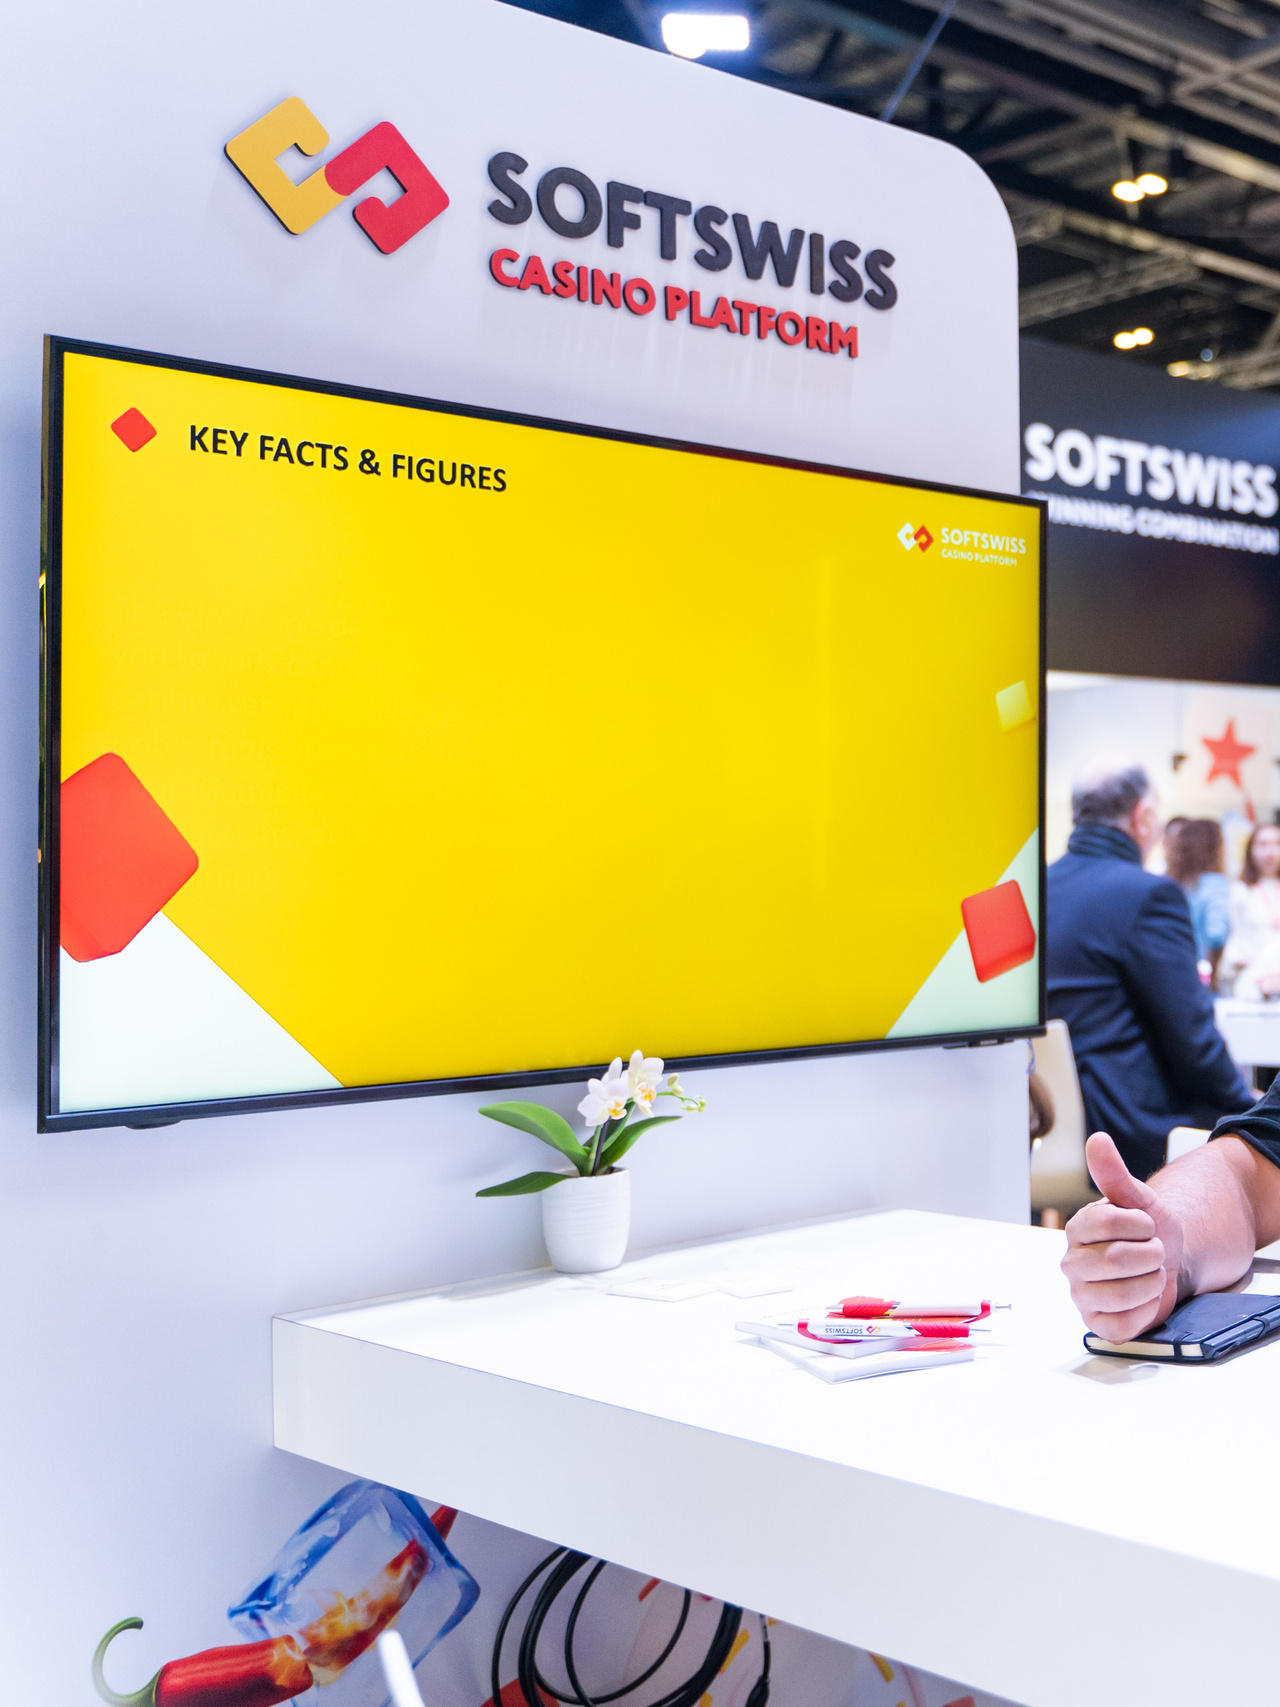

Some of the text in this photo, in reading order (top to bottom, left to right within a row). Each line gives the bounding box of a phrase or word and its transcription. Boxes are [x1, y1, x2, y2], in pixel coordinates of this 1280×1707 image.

[487, 151, 898, 310] SOFTSWISS
[489, 248, 858, 358] CASINO PLATFORM
[190, 424, 507, 493] KEY FACTS & FIGURES
[1024, 422, 1279, 518] SOFTSWISS
[941, 527, 1026, 554] SOFTSWISS
[941, 548, 1017, 567] CASINO PLATFORM
[825, 1327, 863, 1335] SOFTSWISS
